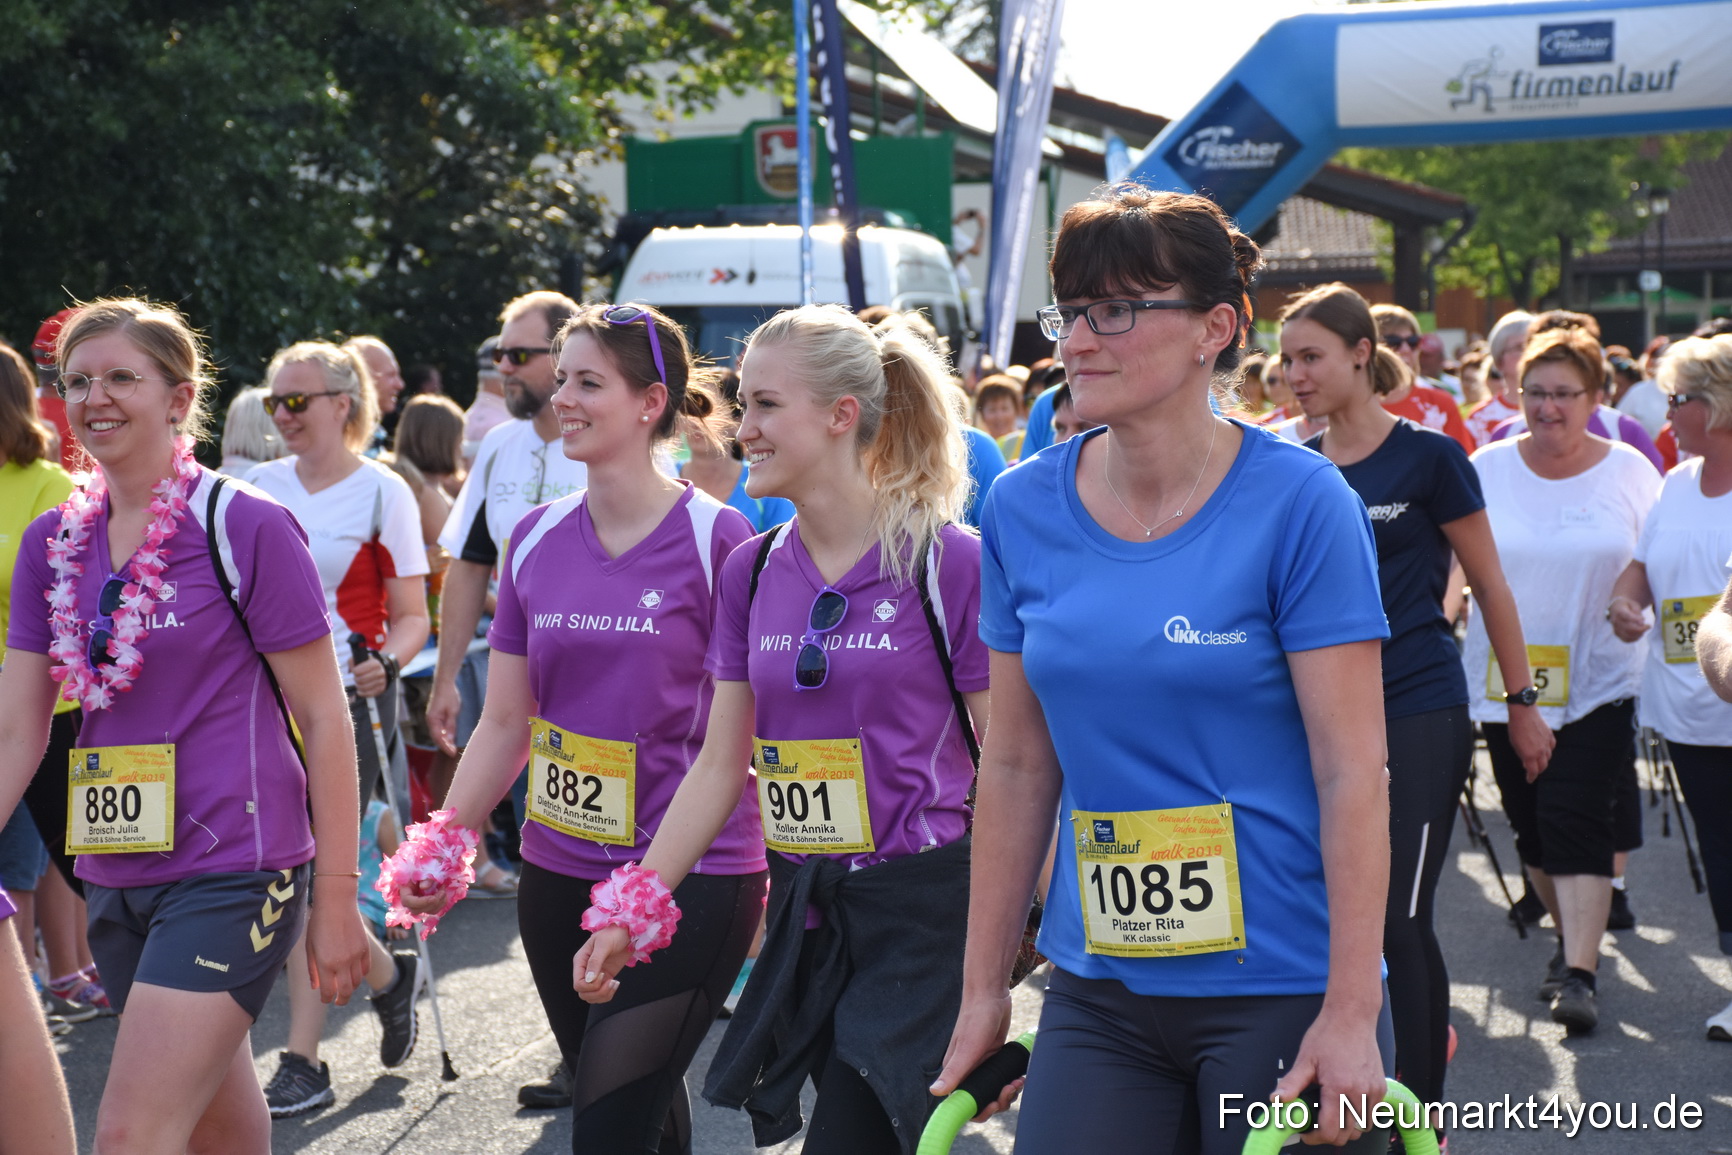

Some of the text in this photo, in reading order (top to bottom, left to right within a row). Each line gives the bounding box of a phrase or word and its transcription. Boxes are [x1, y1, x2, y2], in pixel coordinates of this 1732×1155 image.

[1511, 60, 1682, 98] firmenlauf
[1193, 131, 1284, 161] Fischer
[145, 612, 185, 630] ILA.
[534, 613, 660, 635] WIR SIND LILA.
[760, 634, 792, 651] WIR
[846, 633, 899, 651] LILA.
[1200, 629, 1248, 645] classic
[118, 771, 165, 782] walk 2019
[580, 763, 626, 778] walk 2019
[805, 767, 854, 780] walk 2019
[546, 763, 602, 813] 882
[86, 785, 141, 824] 880
[767, 781, 831, 822] 901
[537, 796, 562, 813] Dietrich
[563, 807, 618, 826] Ann-Kathrin
[543, 809, 558, 821] FUCHS
[583, 822, 607, 833] Service
[775, 823, 836, 834] Koller Annika
[89, 825, 139, 835] Broisch Julia
[773, 833, 789, 842] FUCHS
[818, 835, 844, 843] Service
[1089, 840, 1141, 854] firmenlauf
[1151, 844, 1222, 861] walk 2019
[1091, 861, 1213, 916] 1085
[1112, 918, 1184, 931] Platzer Rita
[1122, 934, 1171, 943] IKK classic
[195, 955, 229, 972] hummel
